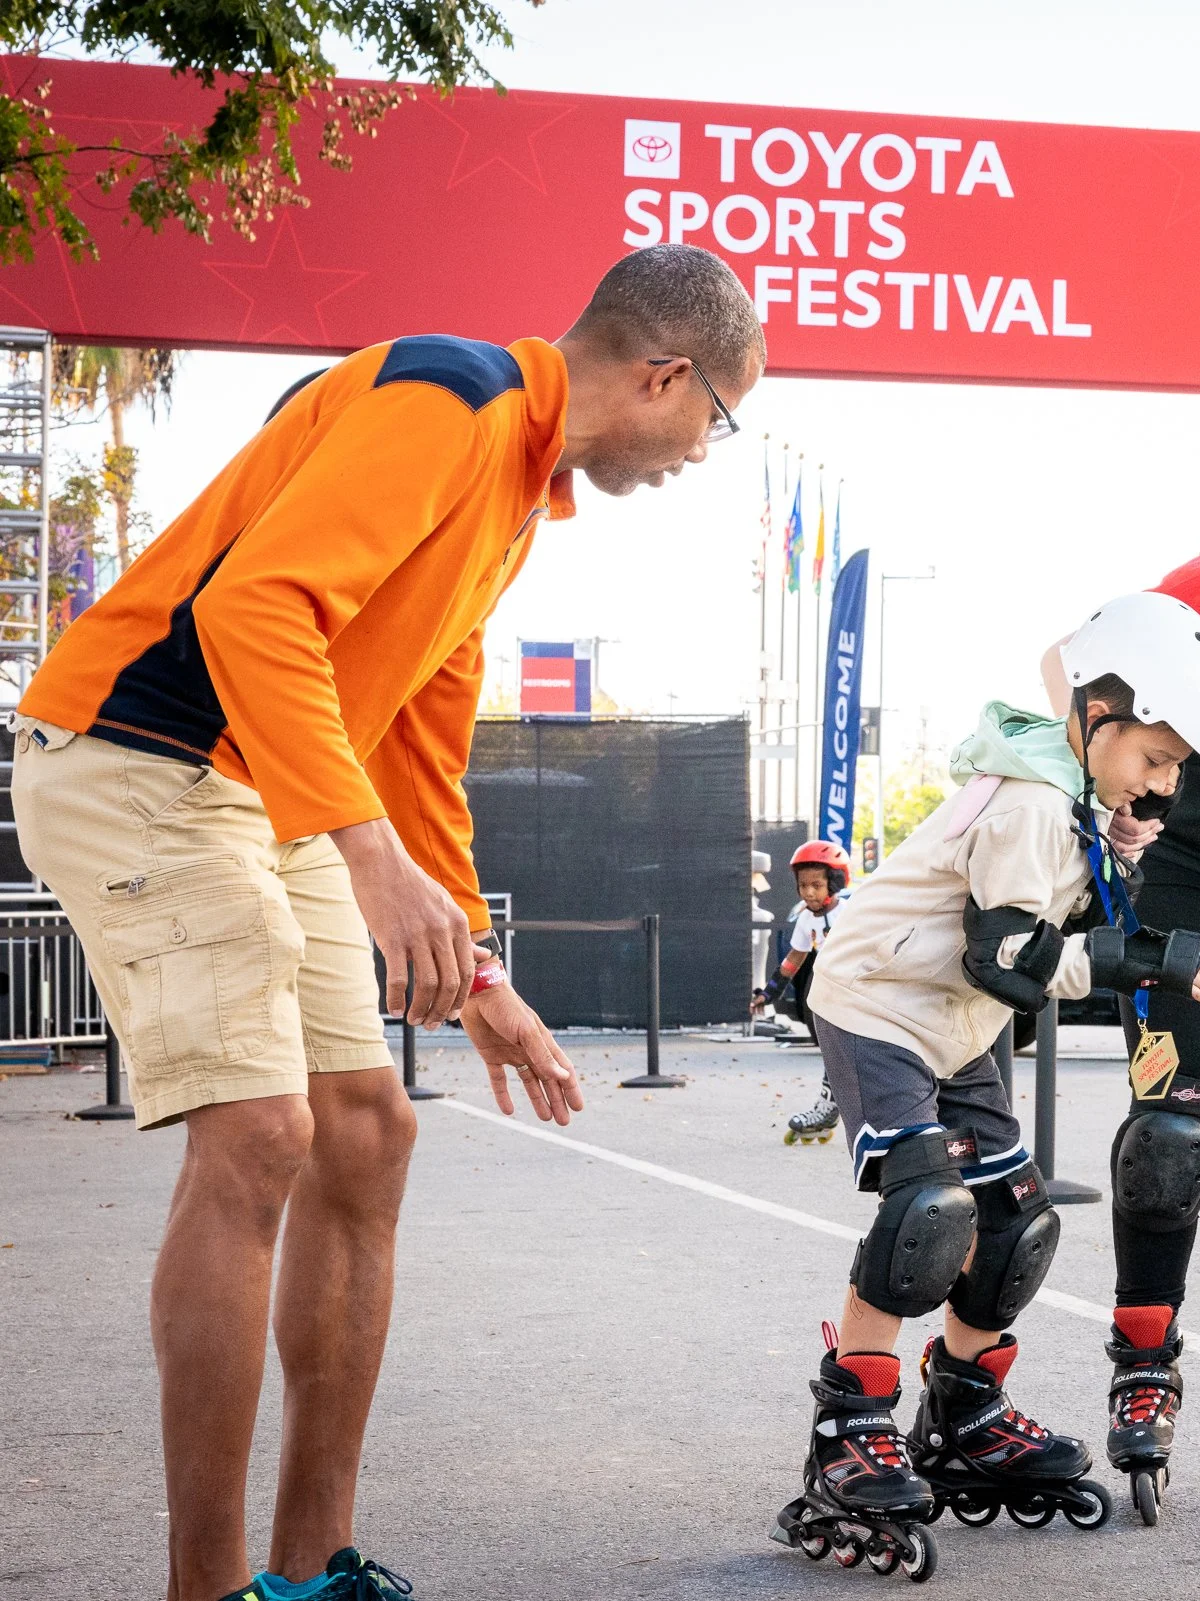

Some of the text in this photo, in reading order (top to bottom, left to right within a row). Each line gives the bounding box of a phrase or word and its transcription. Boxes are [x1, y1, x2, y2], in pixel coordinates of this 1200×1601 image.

[706, 125, 1014, 198] TOYOTA
[623, 189, 907, 260] SPORTS
[756, 264, 1092, 338] FESTIVAL
[826, 629, 855, 849] WELCOME
[1113, 1371, 1170, 1385] ROLLERBLADE
